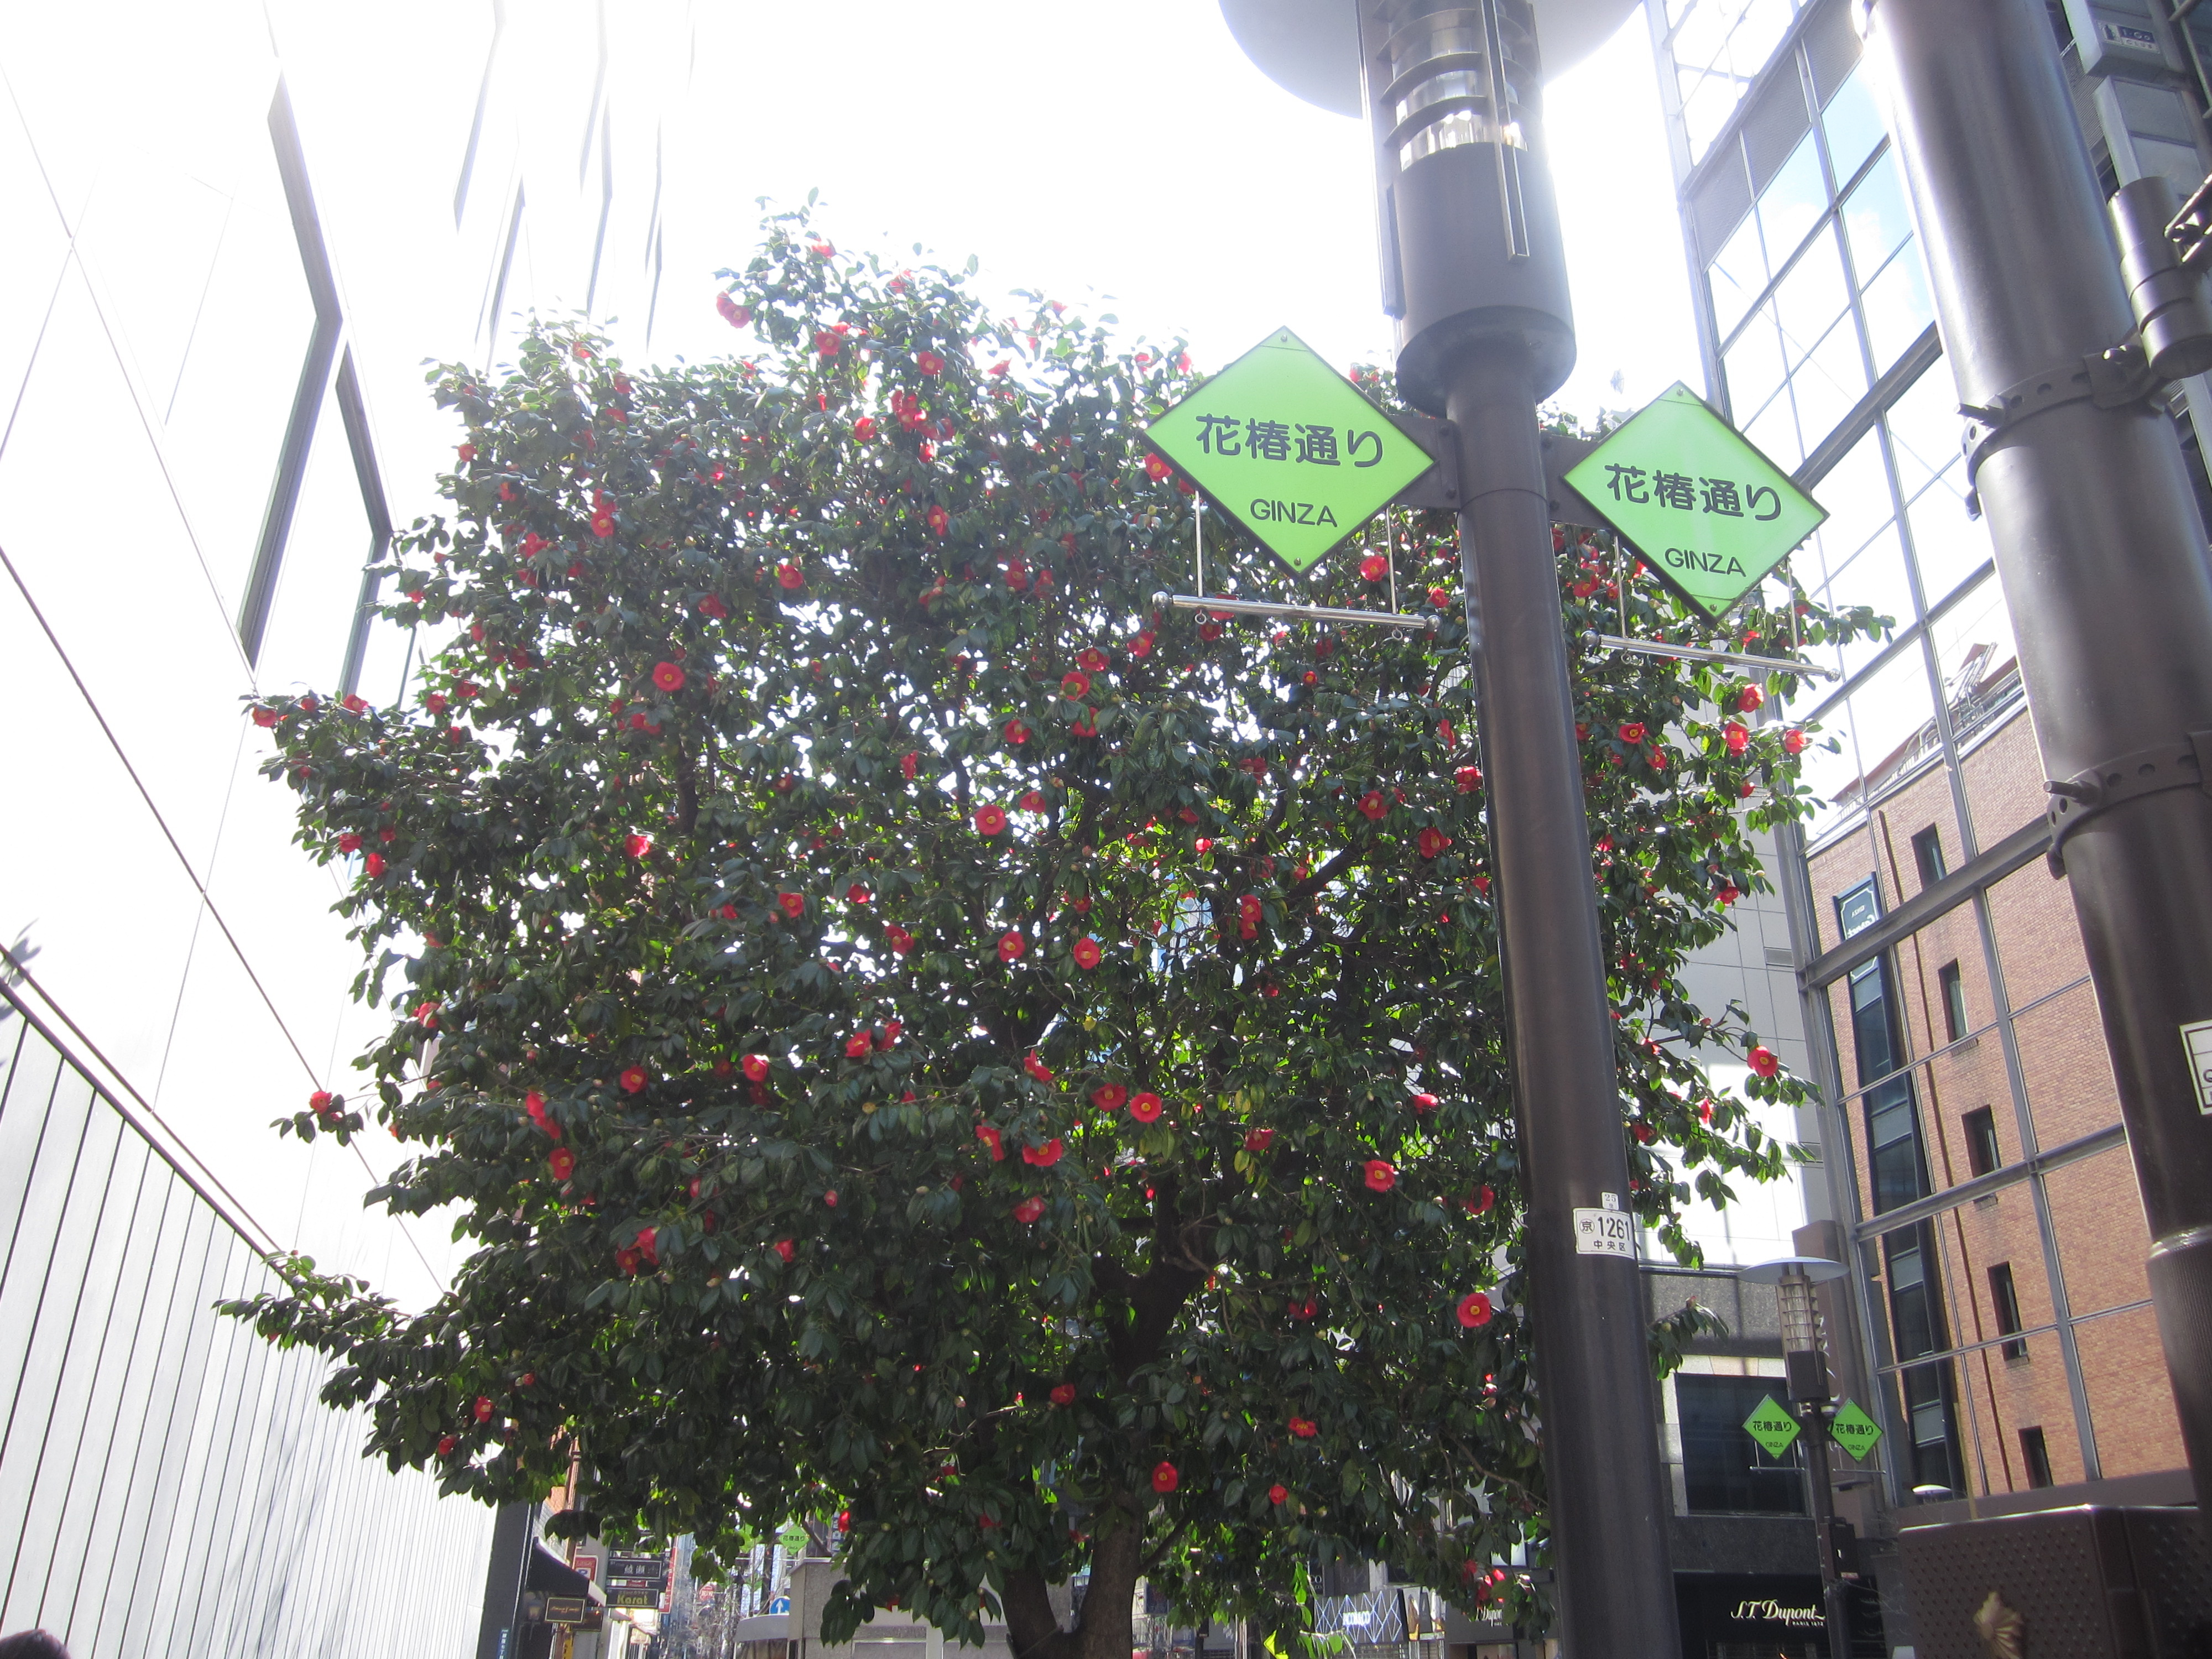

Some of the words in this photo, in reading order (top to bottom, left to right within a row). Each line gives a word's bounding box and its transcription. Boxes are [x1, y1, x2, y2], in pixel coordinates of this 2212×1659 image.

[1196, 413, 1383, 467] 花椿通り
[1604, 463, 1782, 521] 花椿通り
[1250, 499, 1338, 528] GINZA
[1665, 548, 1747, 577] GINZA
[1605, 1194, 1616, 1202] 25
[1580, 1219, 1594, 1233] 京
[1597, 1217, 1630, 1241] 1261
[1593, 1240, 1626, 1251] 中央区
[1752, 1420, 1792, 1432] 花椿通り
[1835, 1423, 1874, 1435] 花椿通り
[617, 1594, 648, 1605] Karat
[1761, 1599, 1826, 1626] Dupont
